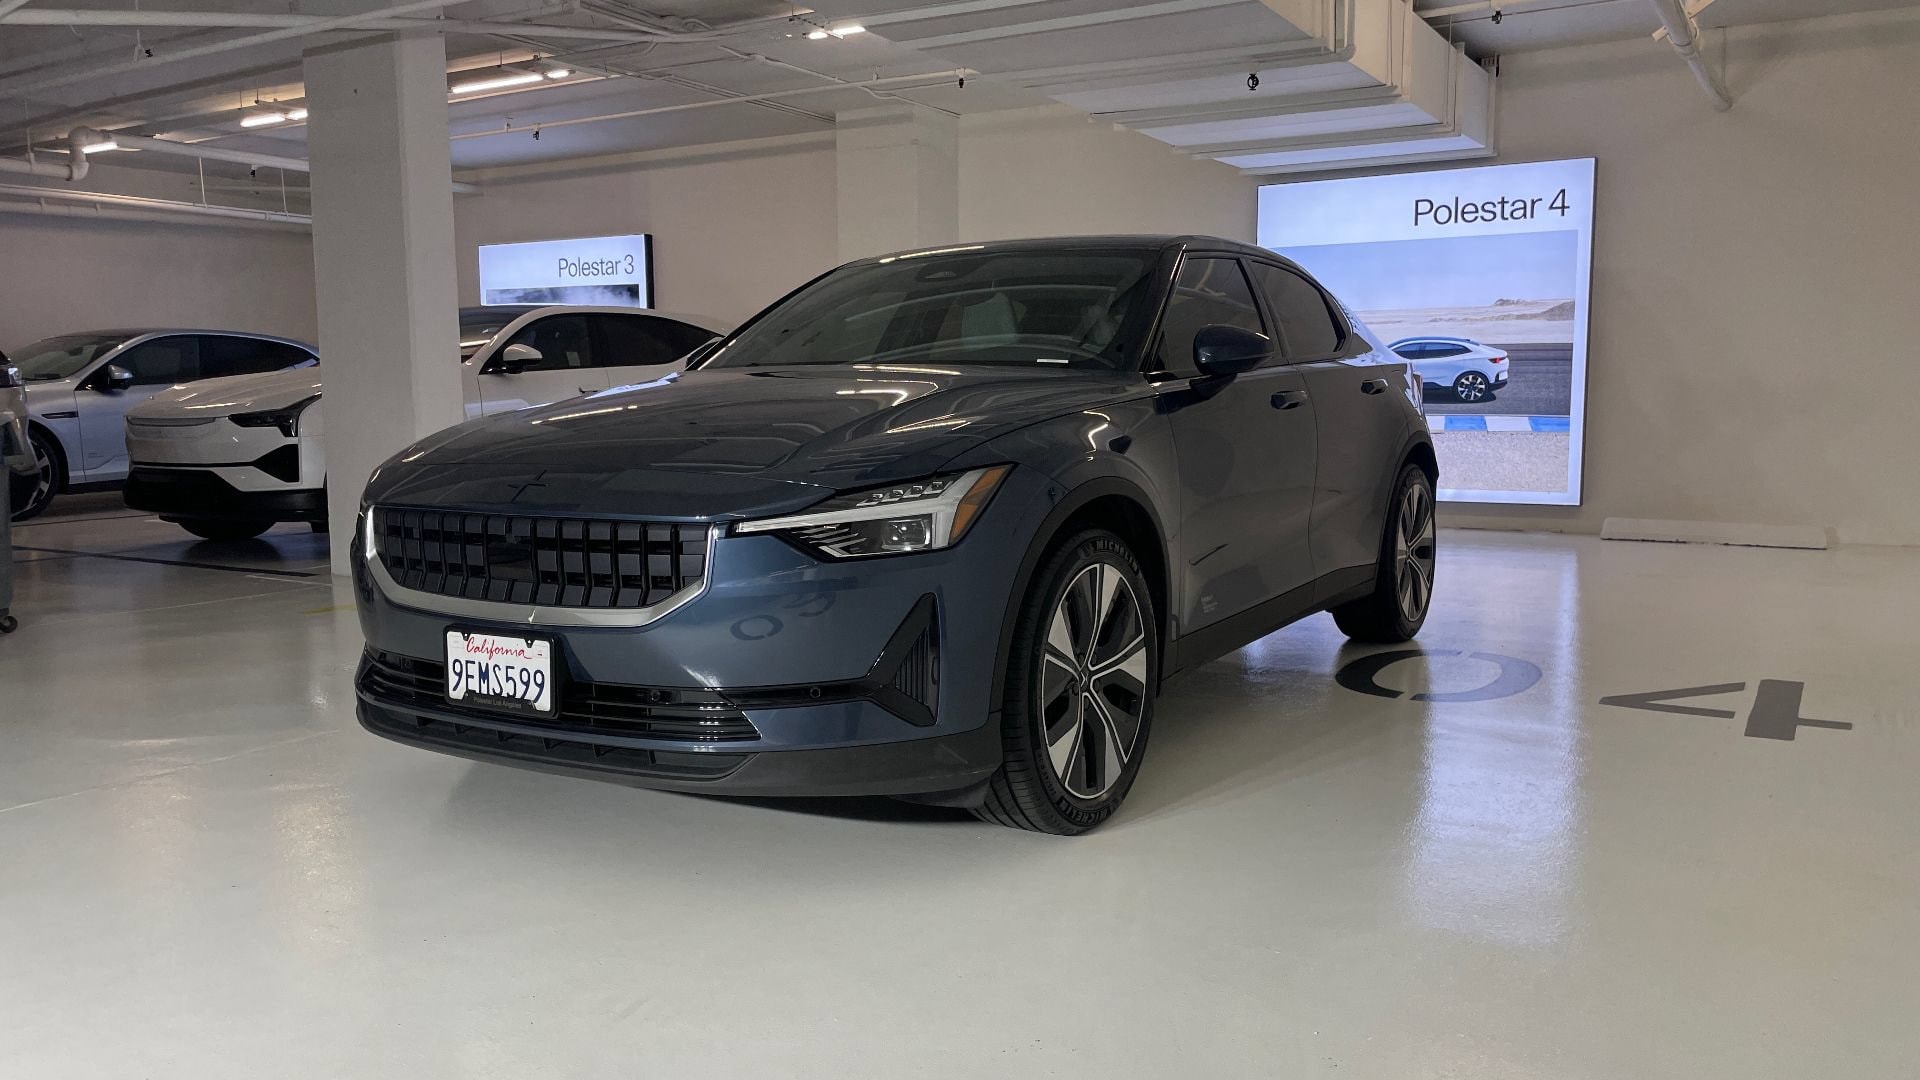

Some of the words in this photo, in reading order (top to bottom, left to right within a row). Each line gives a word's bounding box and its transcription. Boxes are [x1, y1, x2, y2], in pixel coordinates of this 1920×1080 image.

[1414, 196, 1543, 227] Polestar
[1548, 188, 1571, 217] 4
[558, 256, 621, 278] Polestar
[624, 254, 634, 275] 3
[1096, 539, 1139, 573] MICHELIN
[466, 637, 533, 660] California
[452, 658, 545, 704] 9EMS599
